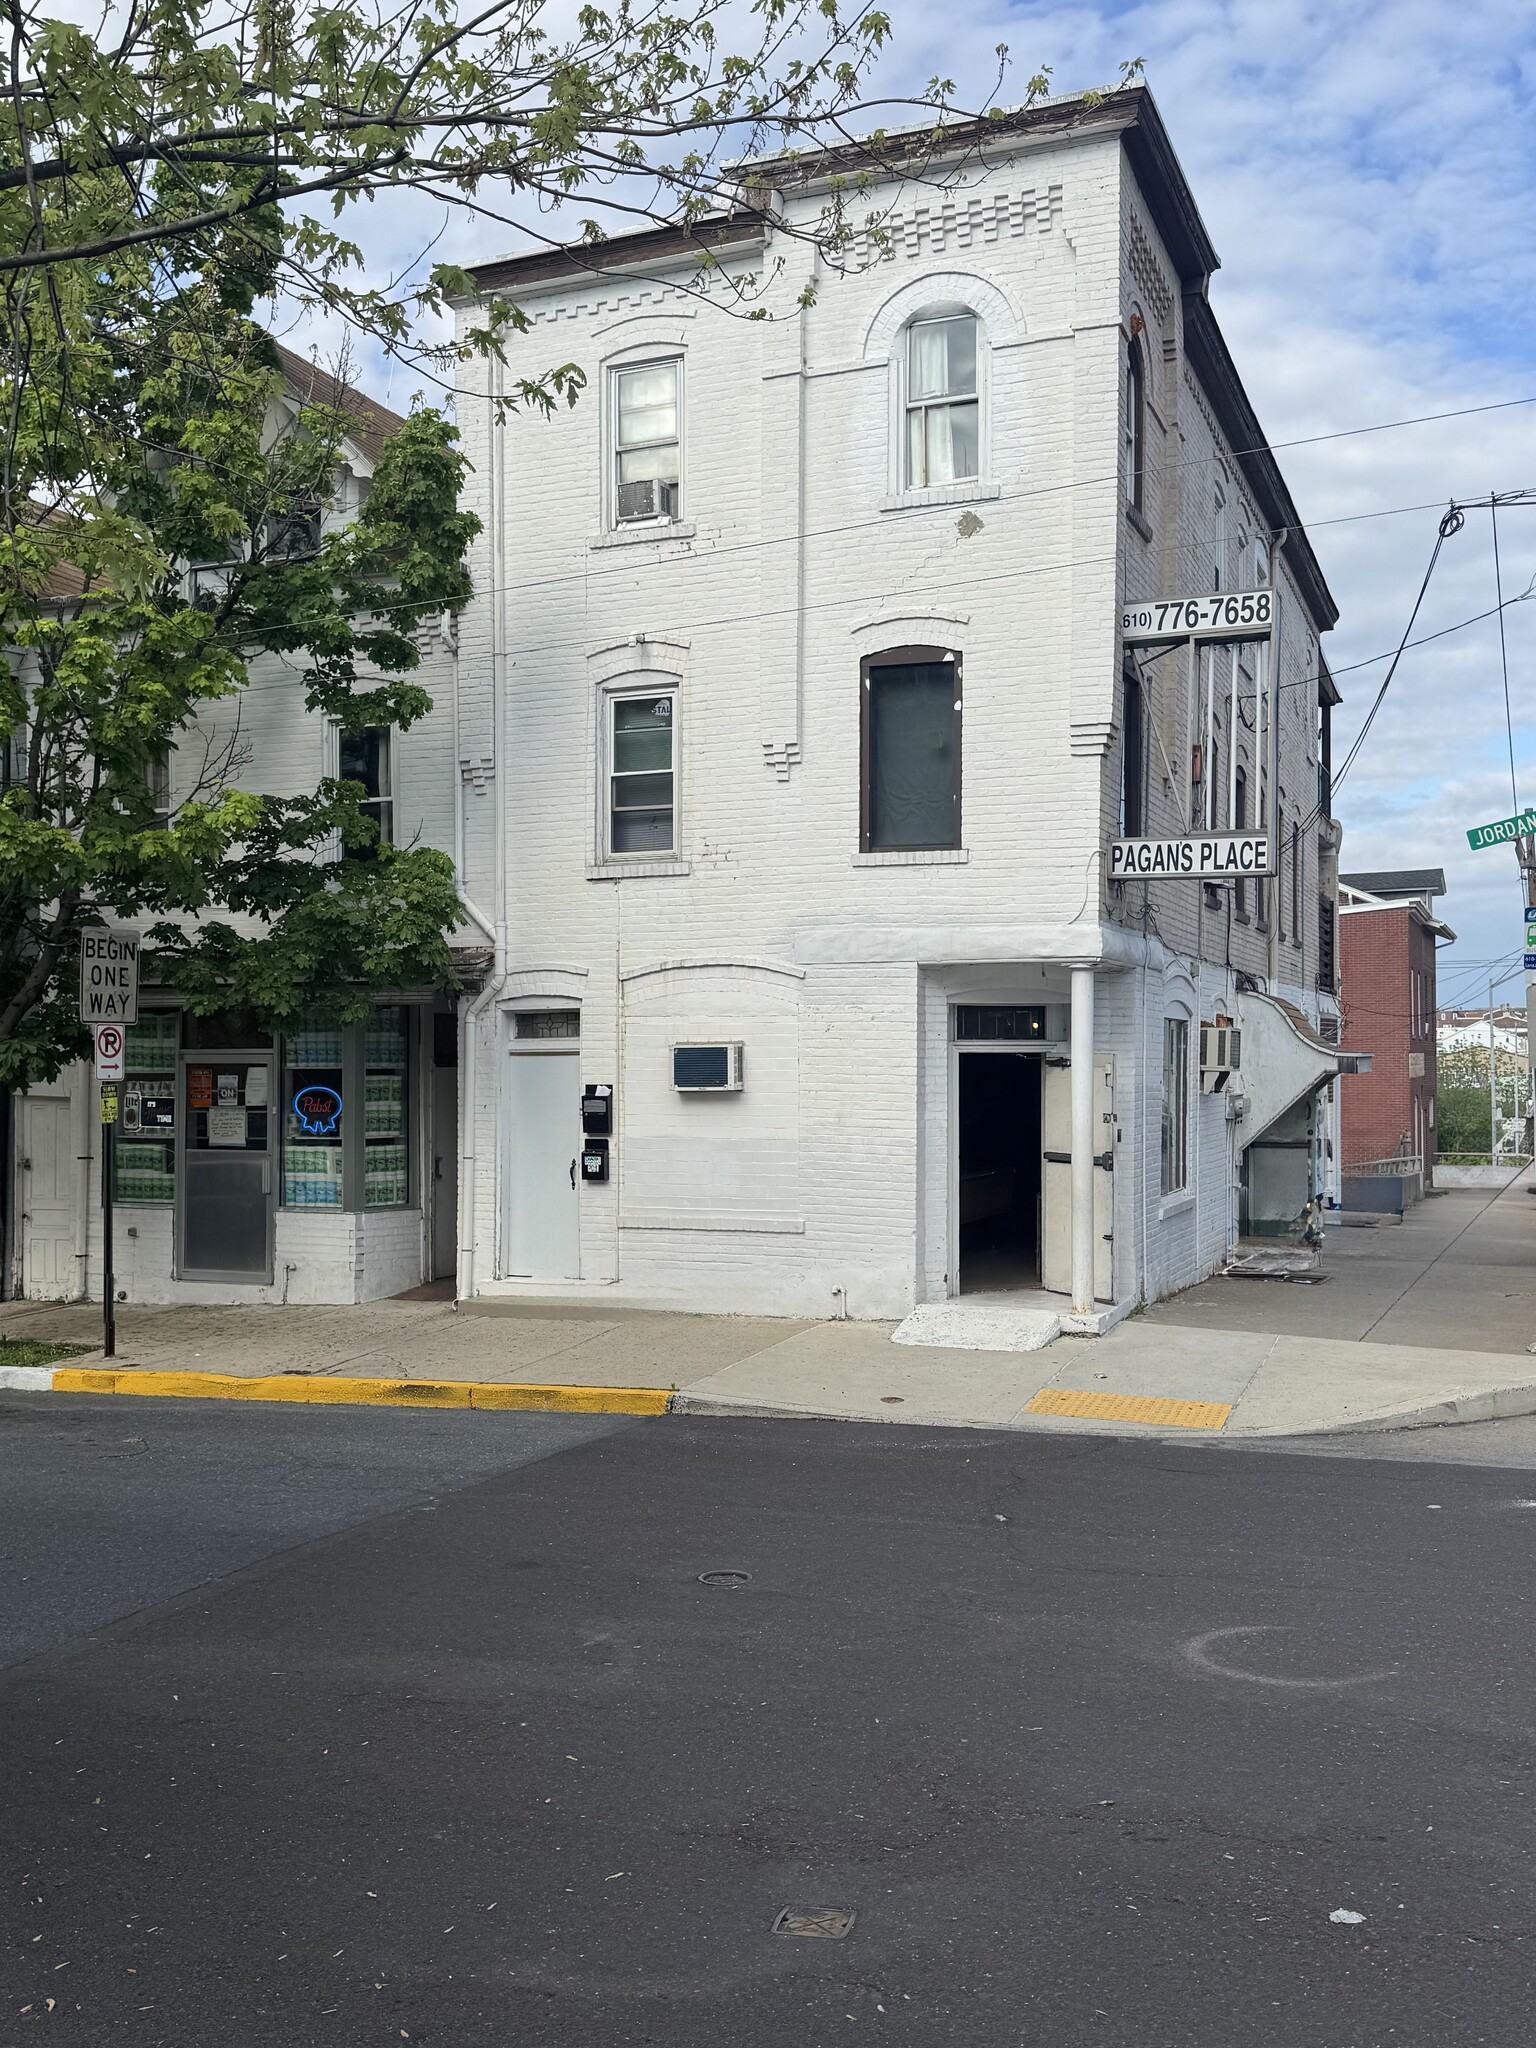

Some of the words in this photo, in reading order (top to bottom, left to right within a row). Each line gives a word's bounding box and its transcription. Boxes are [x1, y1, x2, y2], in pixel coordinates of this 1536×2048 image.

[1154, 593, 1271, 631] 776-7658
[1111, 841, 1193, 873] PAGAN'S
[1200, 840, 1267, 871] PLACE
[85, 937, 135, 961] BEGIN
[91, 965, 129, 987] ONE
[90, 993, 130, 1015] WAY
[221, 1089, 234, 1097] ON
[302, 1096, 335, 1113] Pabst
